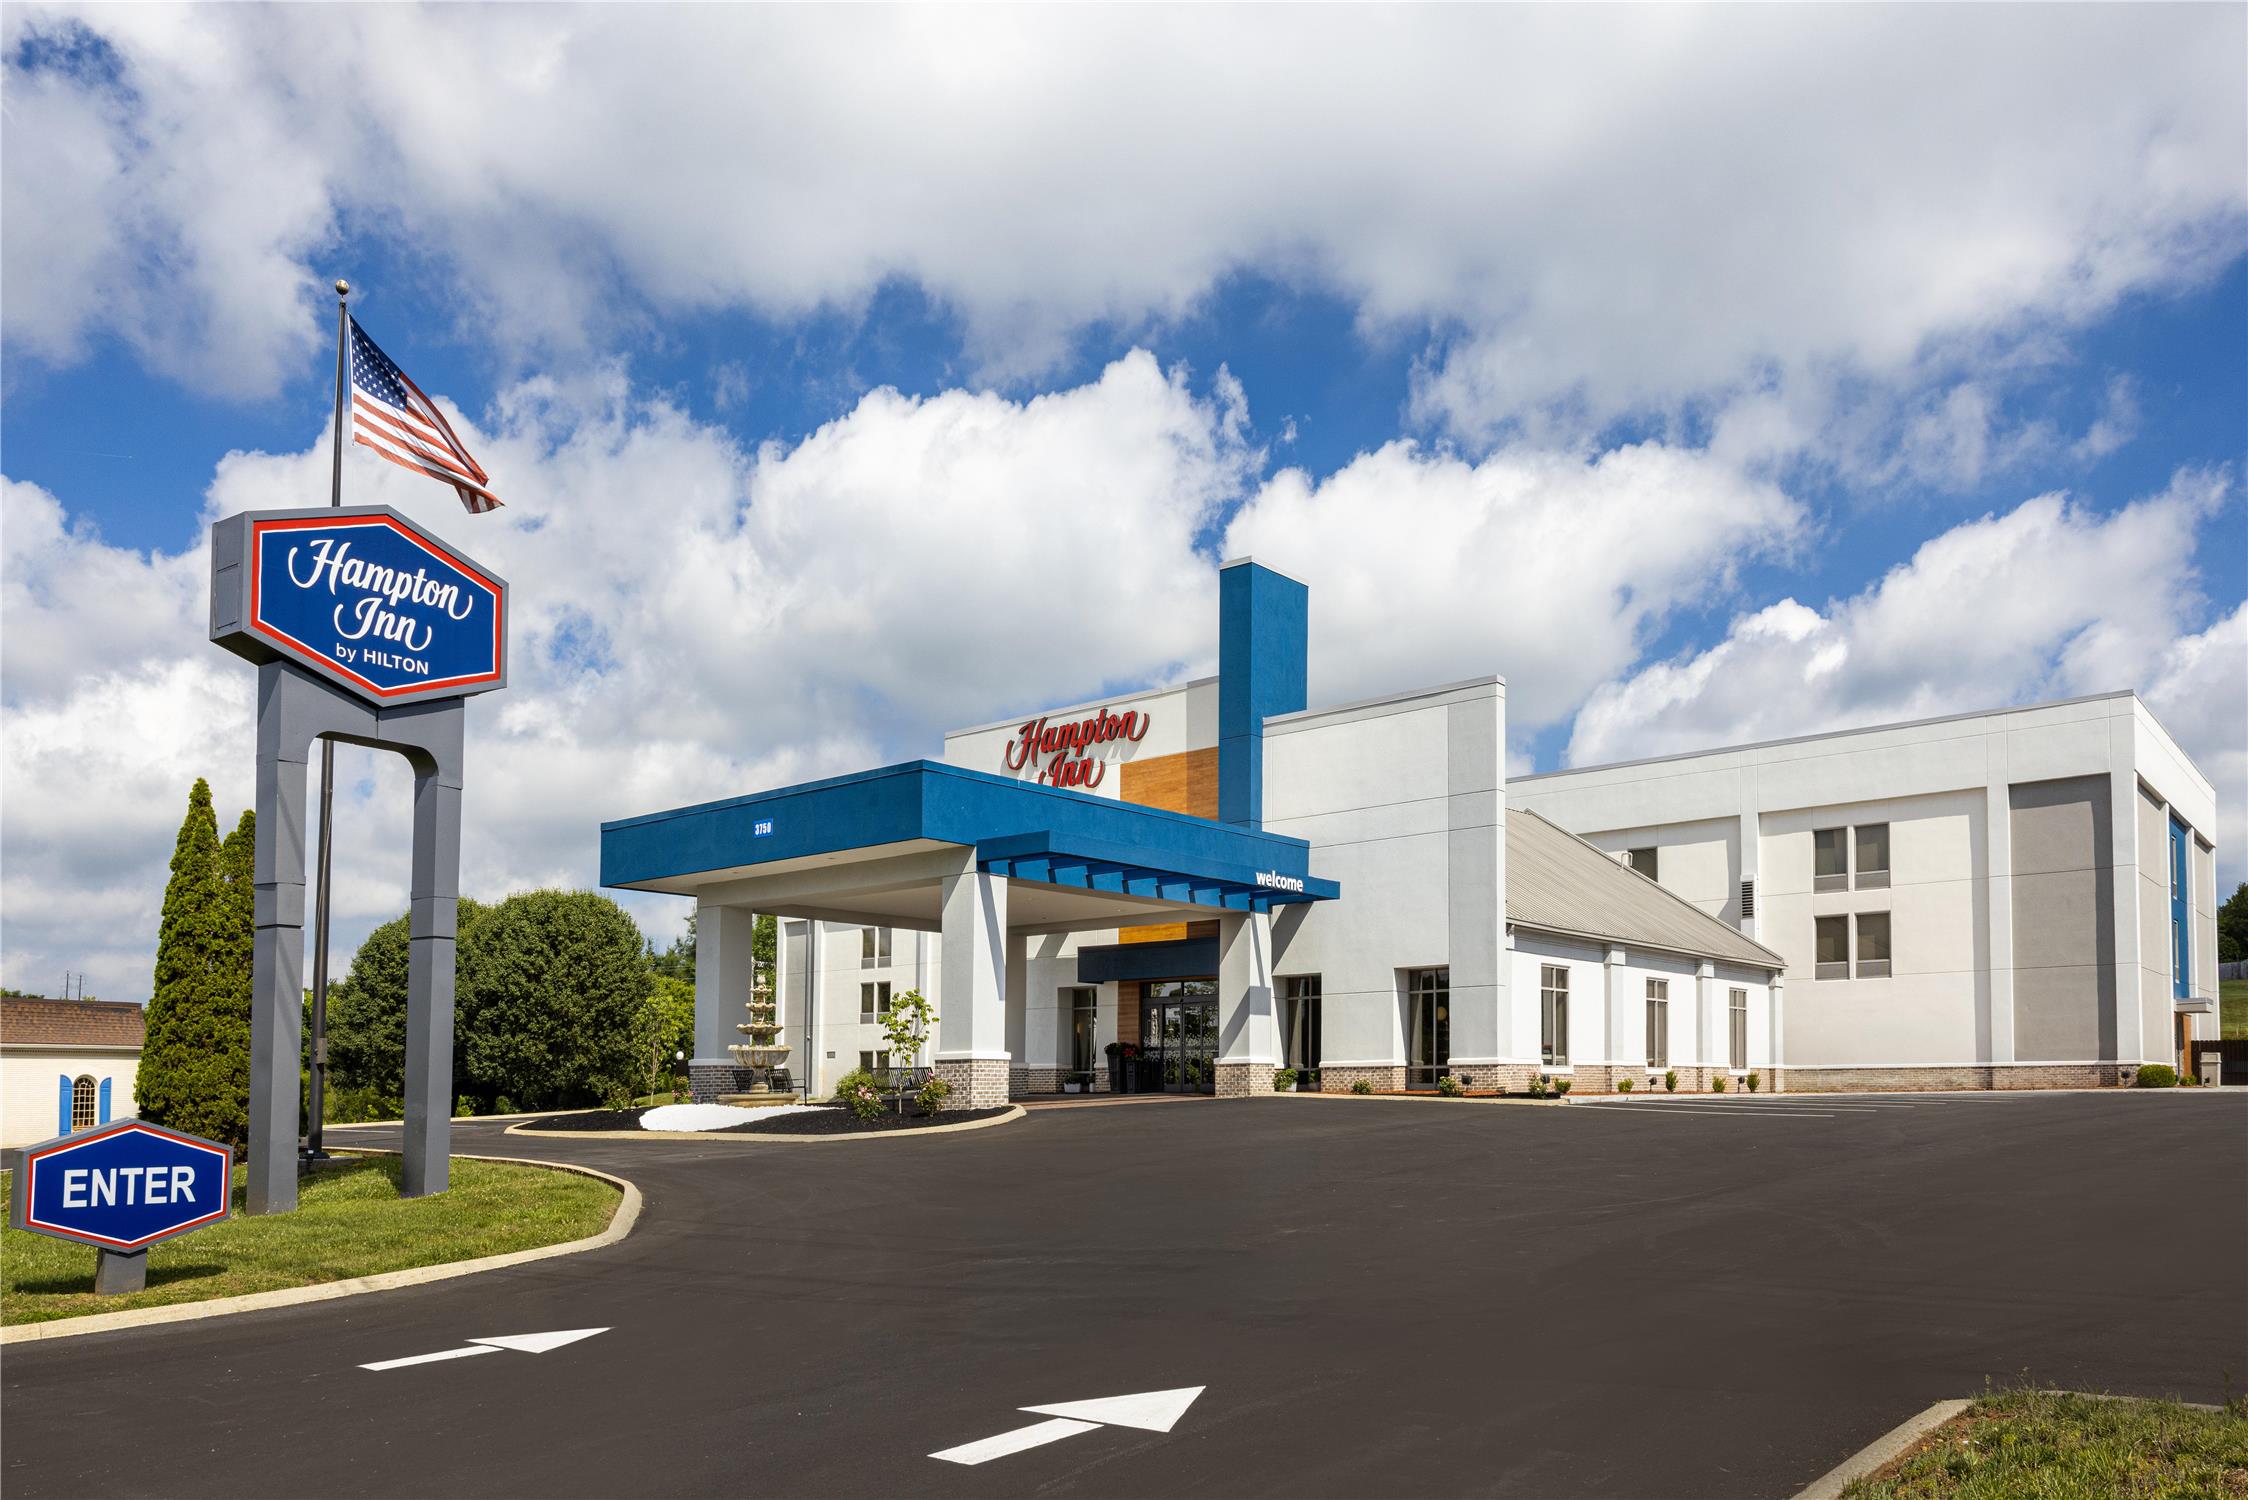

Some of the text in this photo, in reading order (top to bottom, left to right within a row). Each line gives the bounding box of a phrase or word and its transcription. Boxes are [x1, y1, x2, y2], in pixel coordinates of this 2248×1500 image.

[288, 539, 473, 620] Hampton
[333, 598, 432, 651] Inn
[336, 643, 429, 675] by HILTON
[1006, 708, 1149, 770] Hampton
[1038, 751, 1106, 788] Inn
[1256, 870, 1304, 892] welcome
[63, 1166, 196, 1208] ENTER
